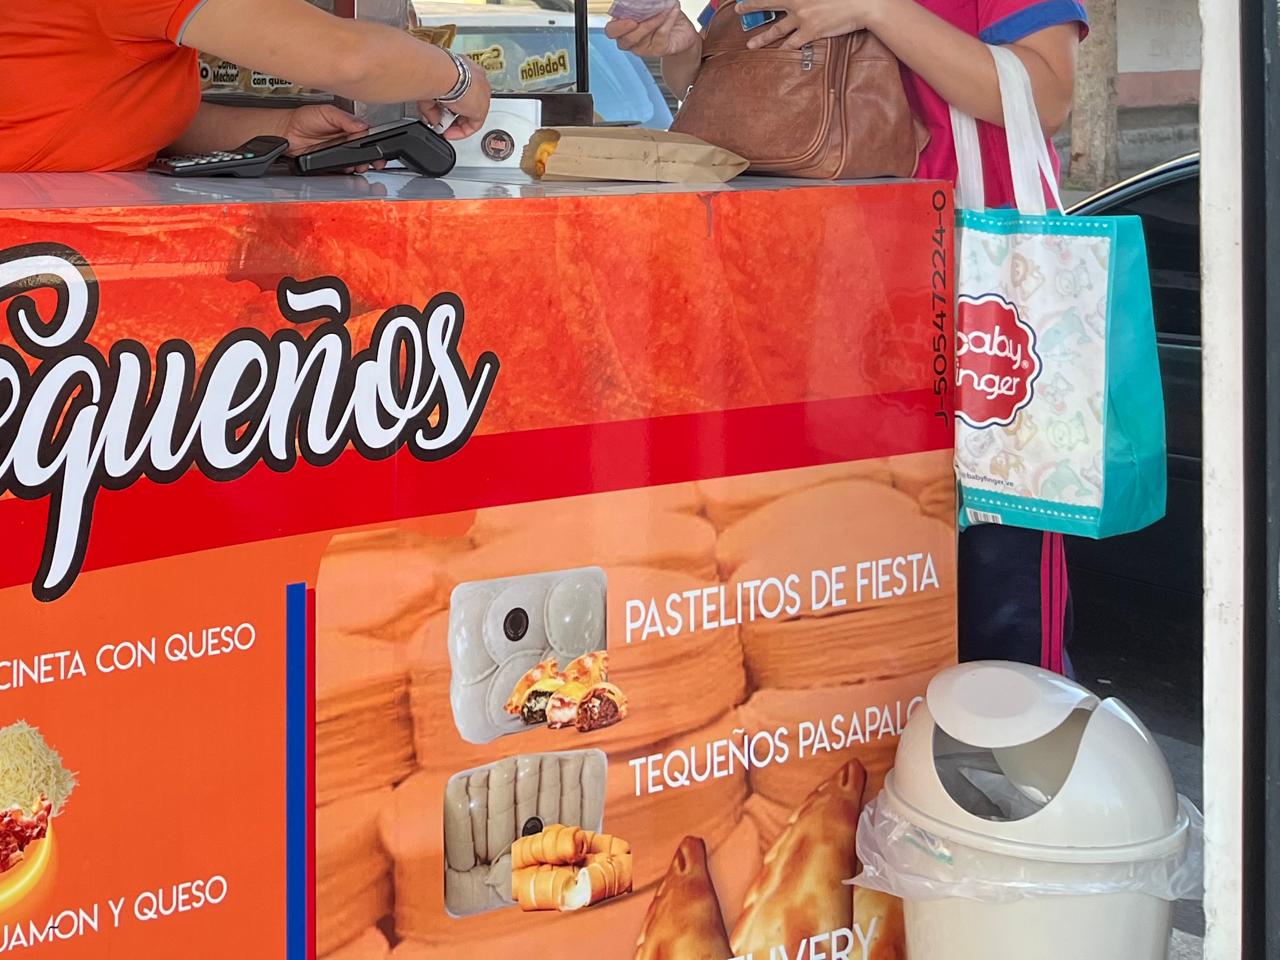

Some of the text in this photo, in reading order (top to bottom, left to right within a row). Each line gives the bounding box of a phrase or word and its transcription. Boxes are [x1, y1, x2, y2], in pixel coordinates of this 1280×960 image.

[625, 552, 940, 644] PASTELITOS DE FIESTA
[96, 637, 156, 673] CON
[165, 622, 256, 662] QUESO
[629, 727, 789, 797] TEQUEÑOS
[106, 898, 125, 928] Y
[133, 875, 228, 922] QUESO
